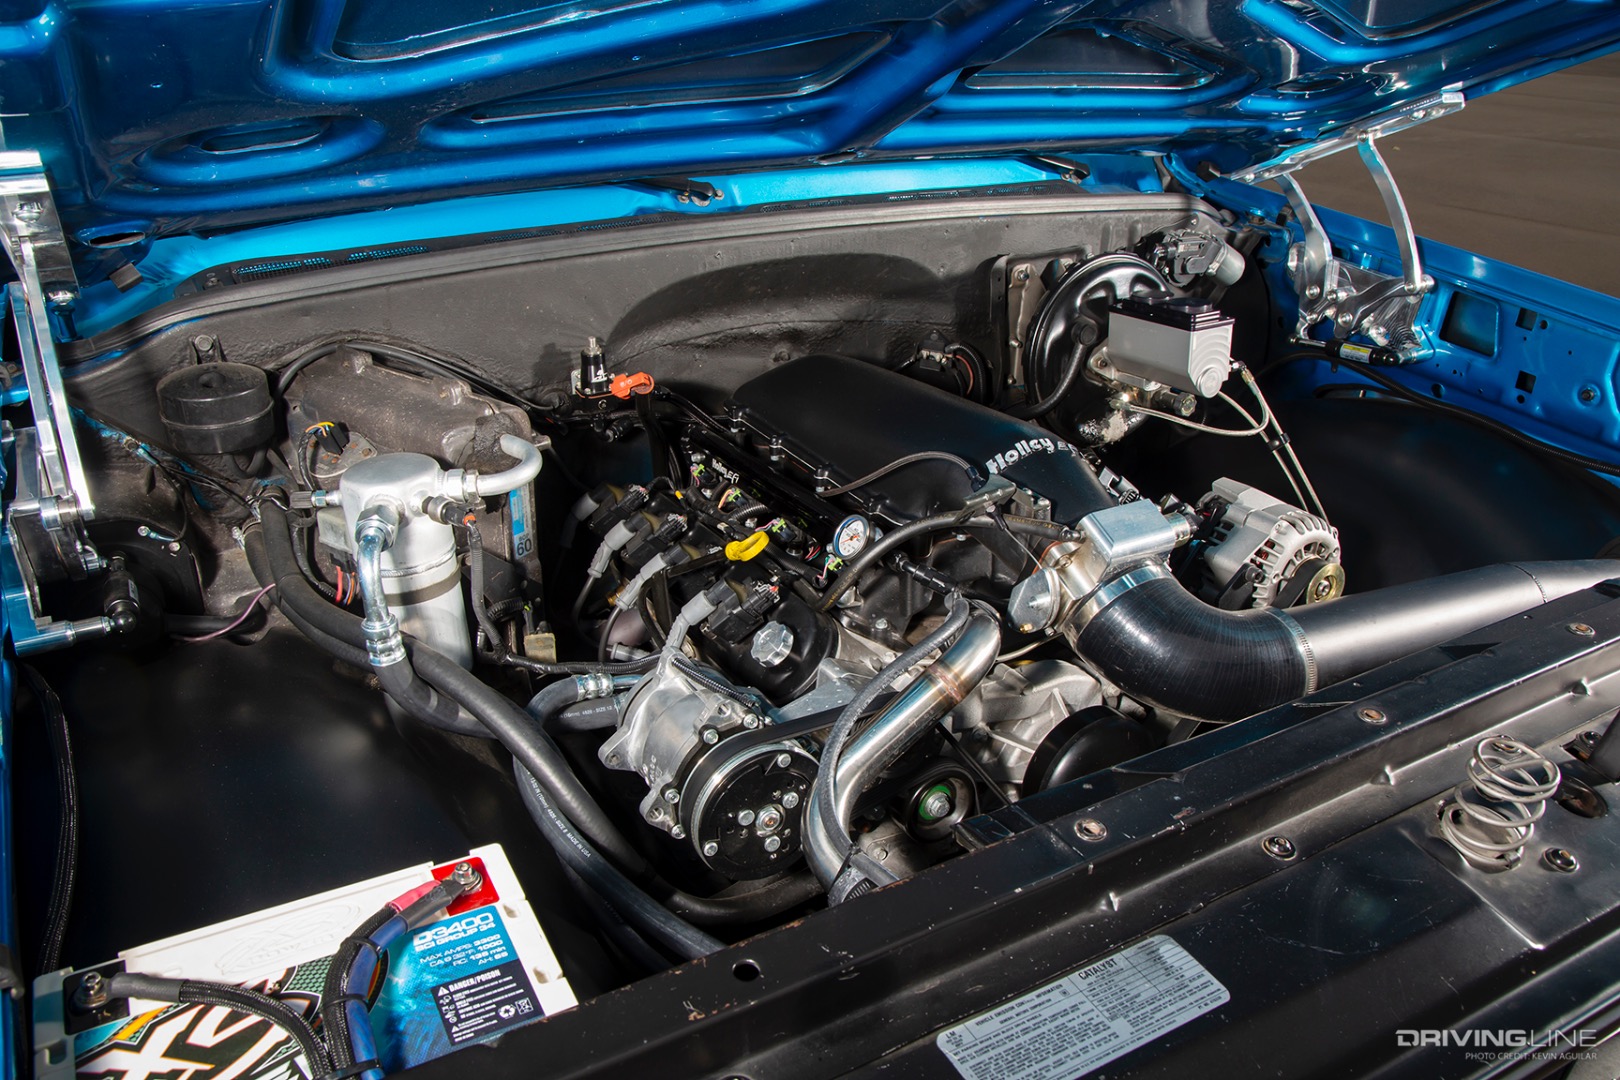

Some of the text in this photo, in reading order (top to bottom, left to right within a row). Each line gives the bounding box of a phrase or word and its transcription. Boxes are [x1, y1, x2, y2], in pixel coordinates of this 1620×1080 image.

[985, 437, 1055, 475] Holley
[516, 538, 532, 556] 60
[566, 831, 579, 846] MADE
[580, 846, 592, 859] USA
[413, 912, 494, 946] D3400
[436, 927, 478, 945] GROUP
[478, 922, 496, 932] 34
[420, 952, 442, 964] MAX
[430, 959, 444, 968] CA
[478, 940, 503, 951] 1000
[490, 946, 506, 955] min
[448, 969, 501, 992] DANGER/POISON
[1078, 958, 1118, 980] CATALYST
